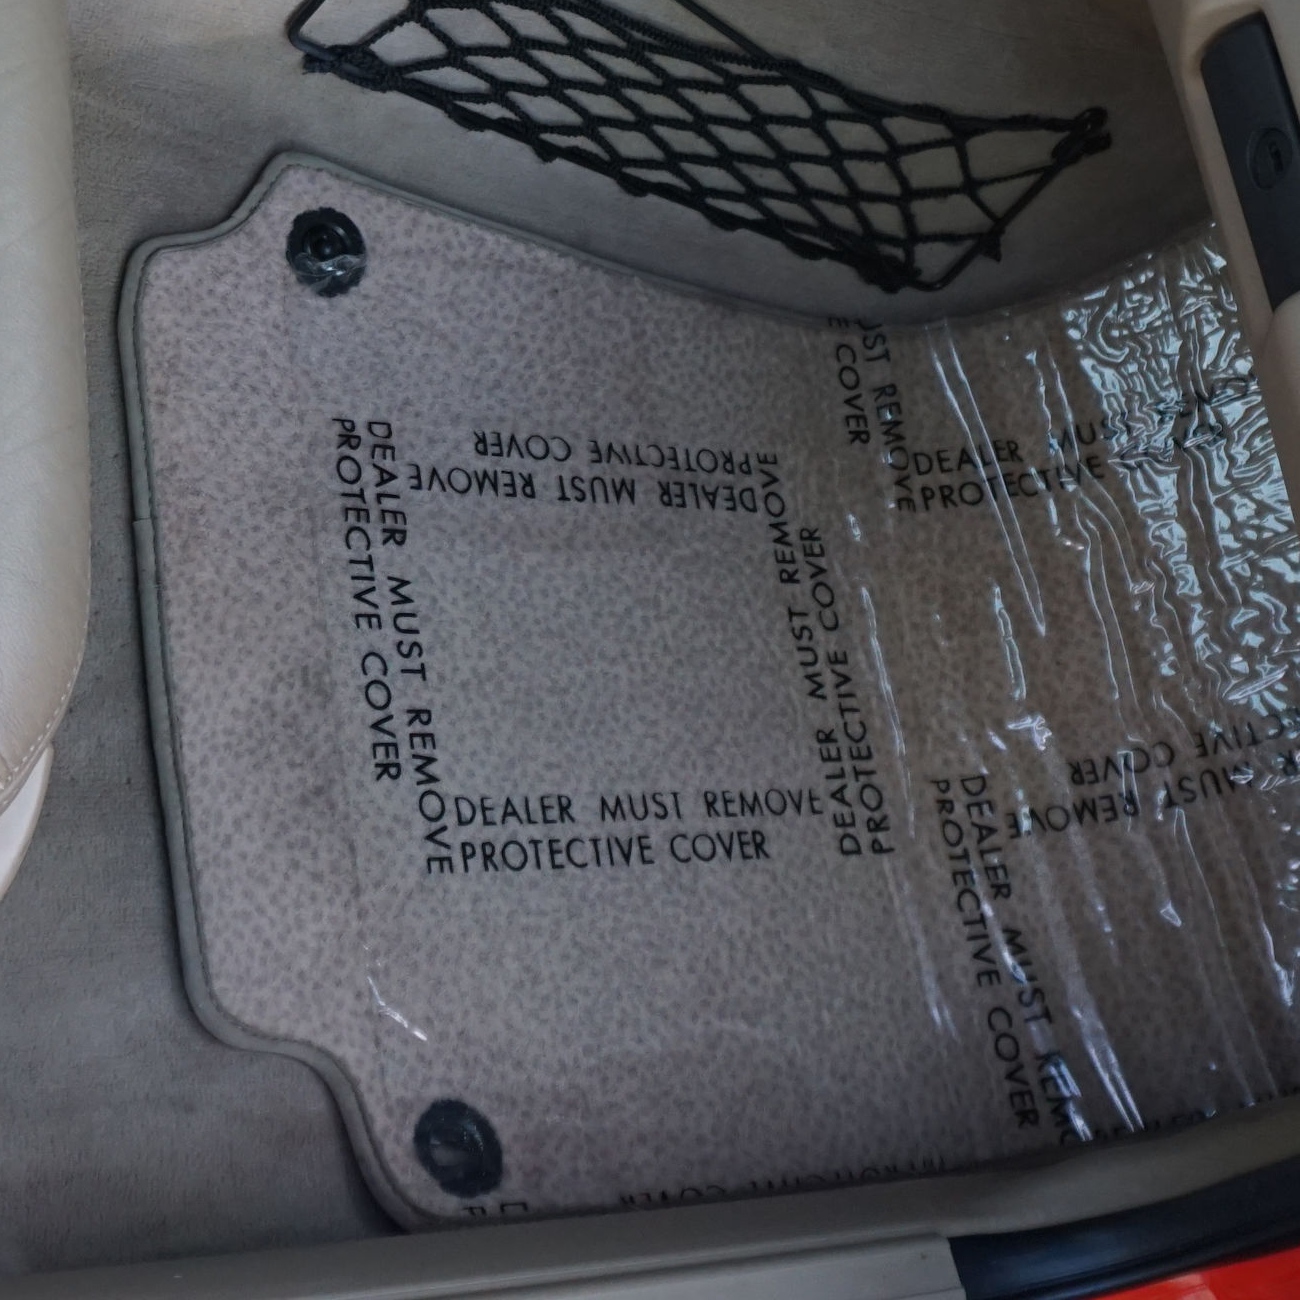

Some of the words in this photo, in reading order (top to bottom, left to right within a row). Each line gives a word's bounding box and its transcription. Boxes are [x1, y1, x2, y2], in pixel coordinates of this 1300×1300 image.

[836, 343, 870, 445] COVER
[367, 419, 407, 547] DEALER
[407, 463, 537, 498] REMOVE
[473, 430, 572, 462] COVER
[557, 473, 636, 505] MUST
[589, 440, 754, 477] PROTECTIVE
[872, 383, 916, 512] REMOVE
[913, 438, 1024, 476] DEALER
[921, 455, 1106, 512] PROTECTIVE
[657, 480, 758, 514] DEALER
[755, 452, 800, 584] REMOVE
[332, 417, 382, 631] PROTECTIVE
[360, 652, 402, 782] COVER
[800, 526, 840, 632] COVER
[386, 576, 427, 683] MUST
[789, 606, 828, 700] MUST
[406, 707, 454, 874] REMOVE
[816, 729, 861, 855] DEALER
[826, 650, 895, 855] PROTECTIVE
[1069, 741, 1175, 786] COVER
[454, 793, 576, 827] DEALER
[600, 790, 683, 821] MUST
[703, 787, 823, 818] REMOVE
[459, 835, 654, 874] PROTECTIVE
[670, 829, 770, 862] COVER
[1008, 789, 1140, 839] REMOVE
[960, 774, 1012, 901] DEALER
[1002, 927, 1053, 1025] MUST
[930, 779, 1000, 987] PROTECTIVE
[987, 1007, 1040, 1128] COVER
